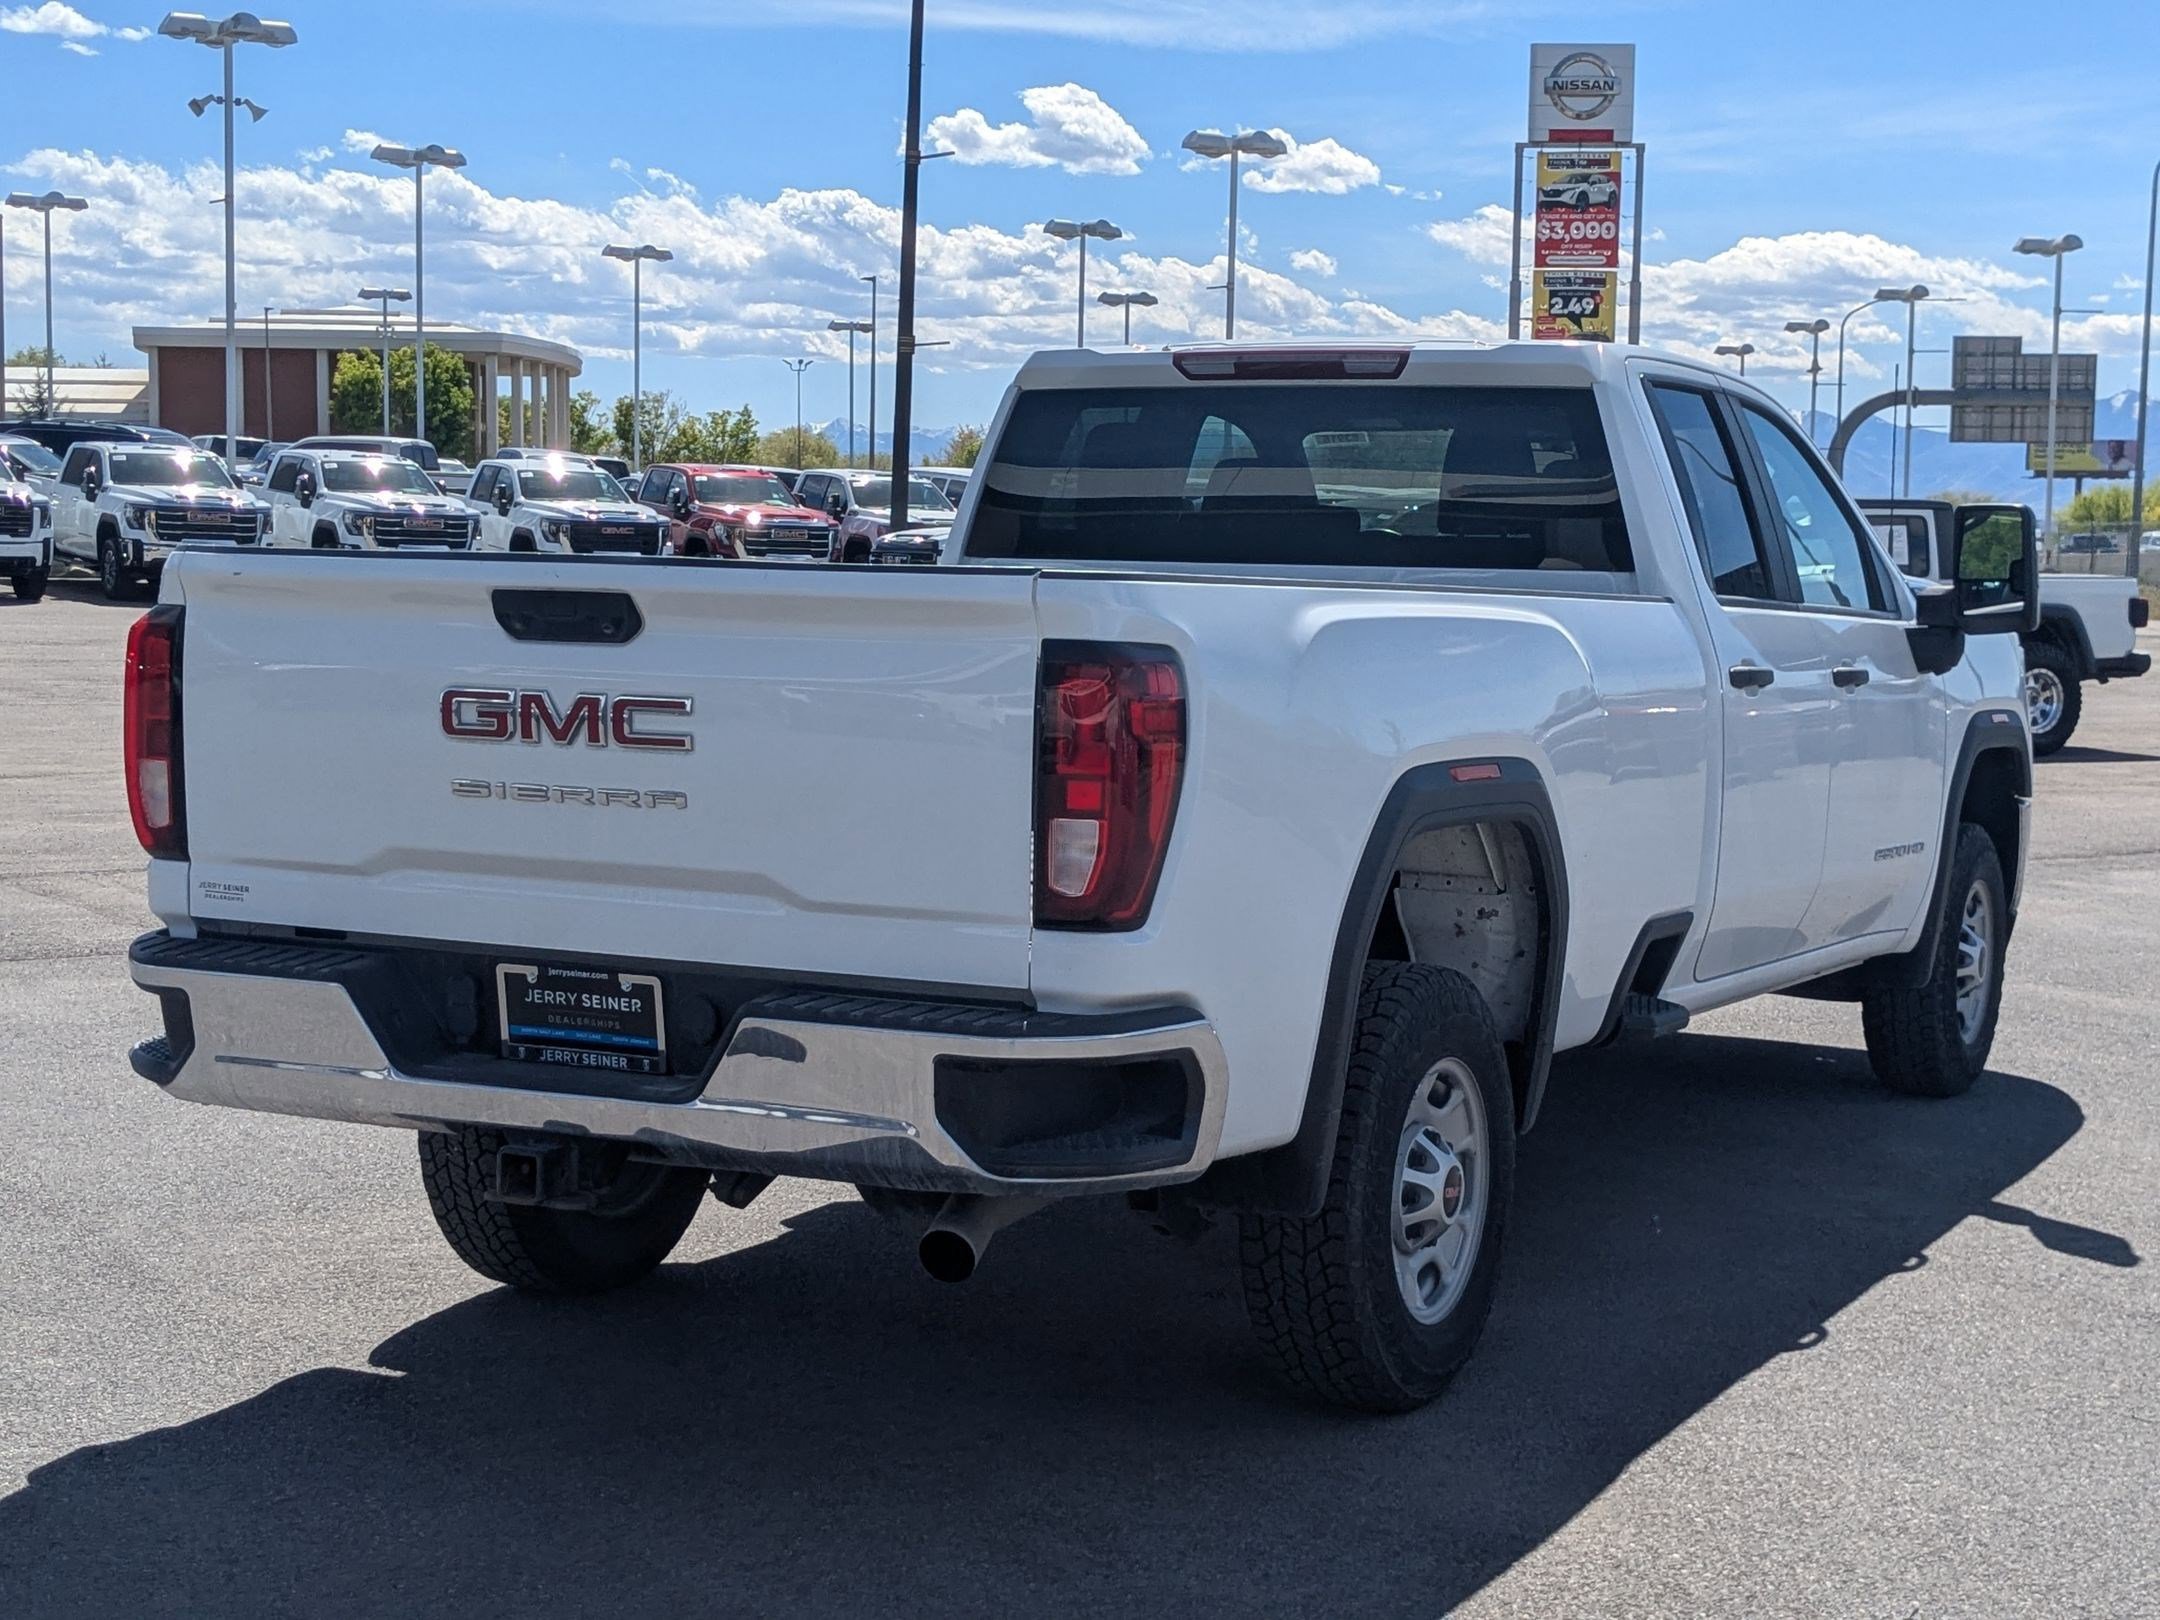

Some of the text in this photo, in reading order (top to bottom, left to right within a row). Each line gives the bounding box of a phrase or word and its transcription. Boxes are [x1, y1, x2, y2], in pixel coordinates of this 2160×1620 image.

[1552, 79, 1615, 91] NISSAN
[1537, 219, 1616, 243] $3,000
[601, 526, 635, 535] GMC
[439, 685, 694, 752] GMC
[451, 778, 688, 810] SIERRA
[548, 967, 609, 980] jerryseiner.com
[525, 988, 642, 1013] JERRY SEINER
[547, 1015, 621, 1030] DEALERSHIPS
[539, 1049, 628, 1069] JERRY SEINER
